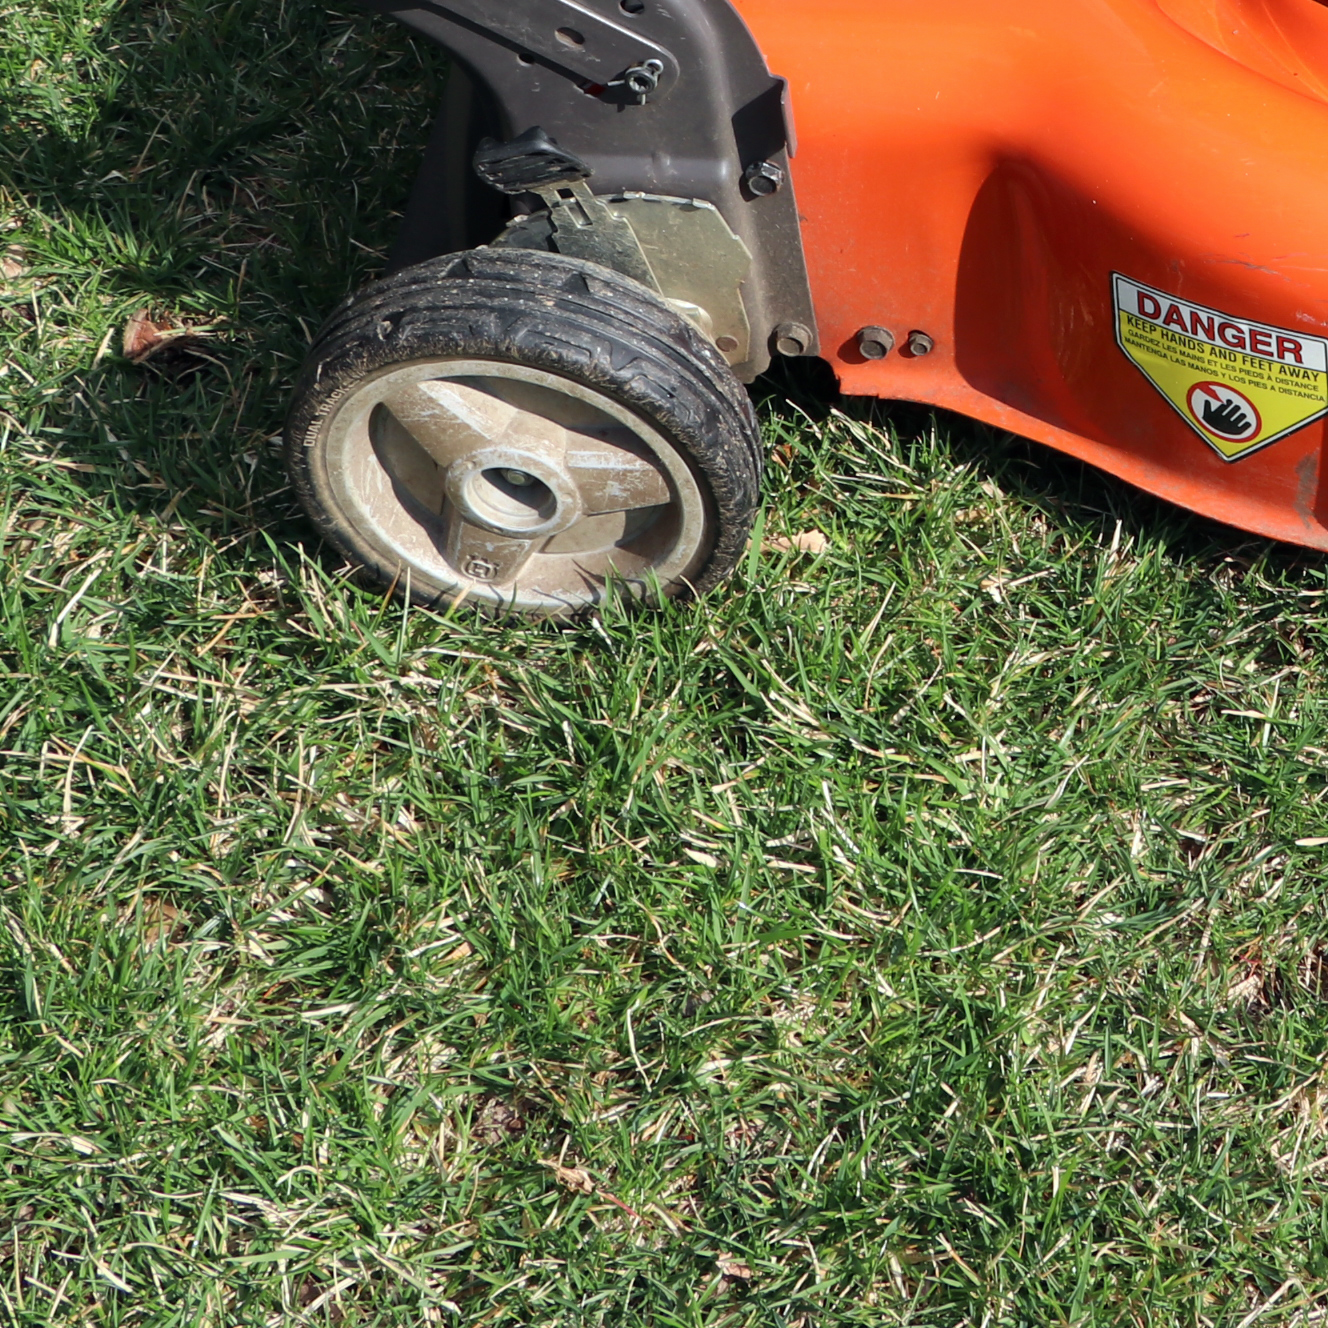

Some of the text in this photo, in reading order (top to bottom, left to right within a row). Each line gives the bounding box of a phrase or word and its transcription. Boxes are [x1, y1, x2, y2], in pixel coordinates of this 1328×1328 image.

[1127, 315, 1319, 382] KEEP HANDS AND FEET AWAY
[1128, 329, 1161, 347] GARDEZ
[1162, 341, 1177, 352] LES
[1179, 347, 1205, 364] MAINS
[1207, 358, 1218, 366] ET
[1220, 362, 1237, 372] LES
[1239, 367, 1265, 380] PIEDS
[1275, 376, 1319, 392] DISTANCE
[1137, 290, 1304, 364] DANGER
[1125, 336, 1168, 359] MANTENGA
[1170, 355, 1186, 366] LAS
[1188, 361, 1219, 377] MANOS
[1229, 374, 1246, 384] LOS
[1248, 380, 1268, 390] PIES
[1270, 384, 1276, 392] A
[1278, 388, 1325, 403] DISTANCIA
[303, 419, 324, 447] DUAL
